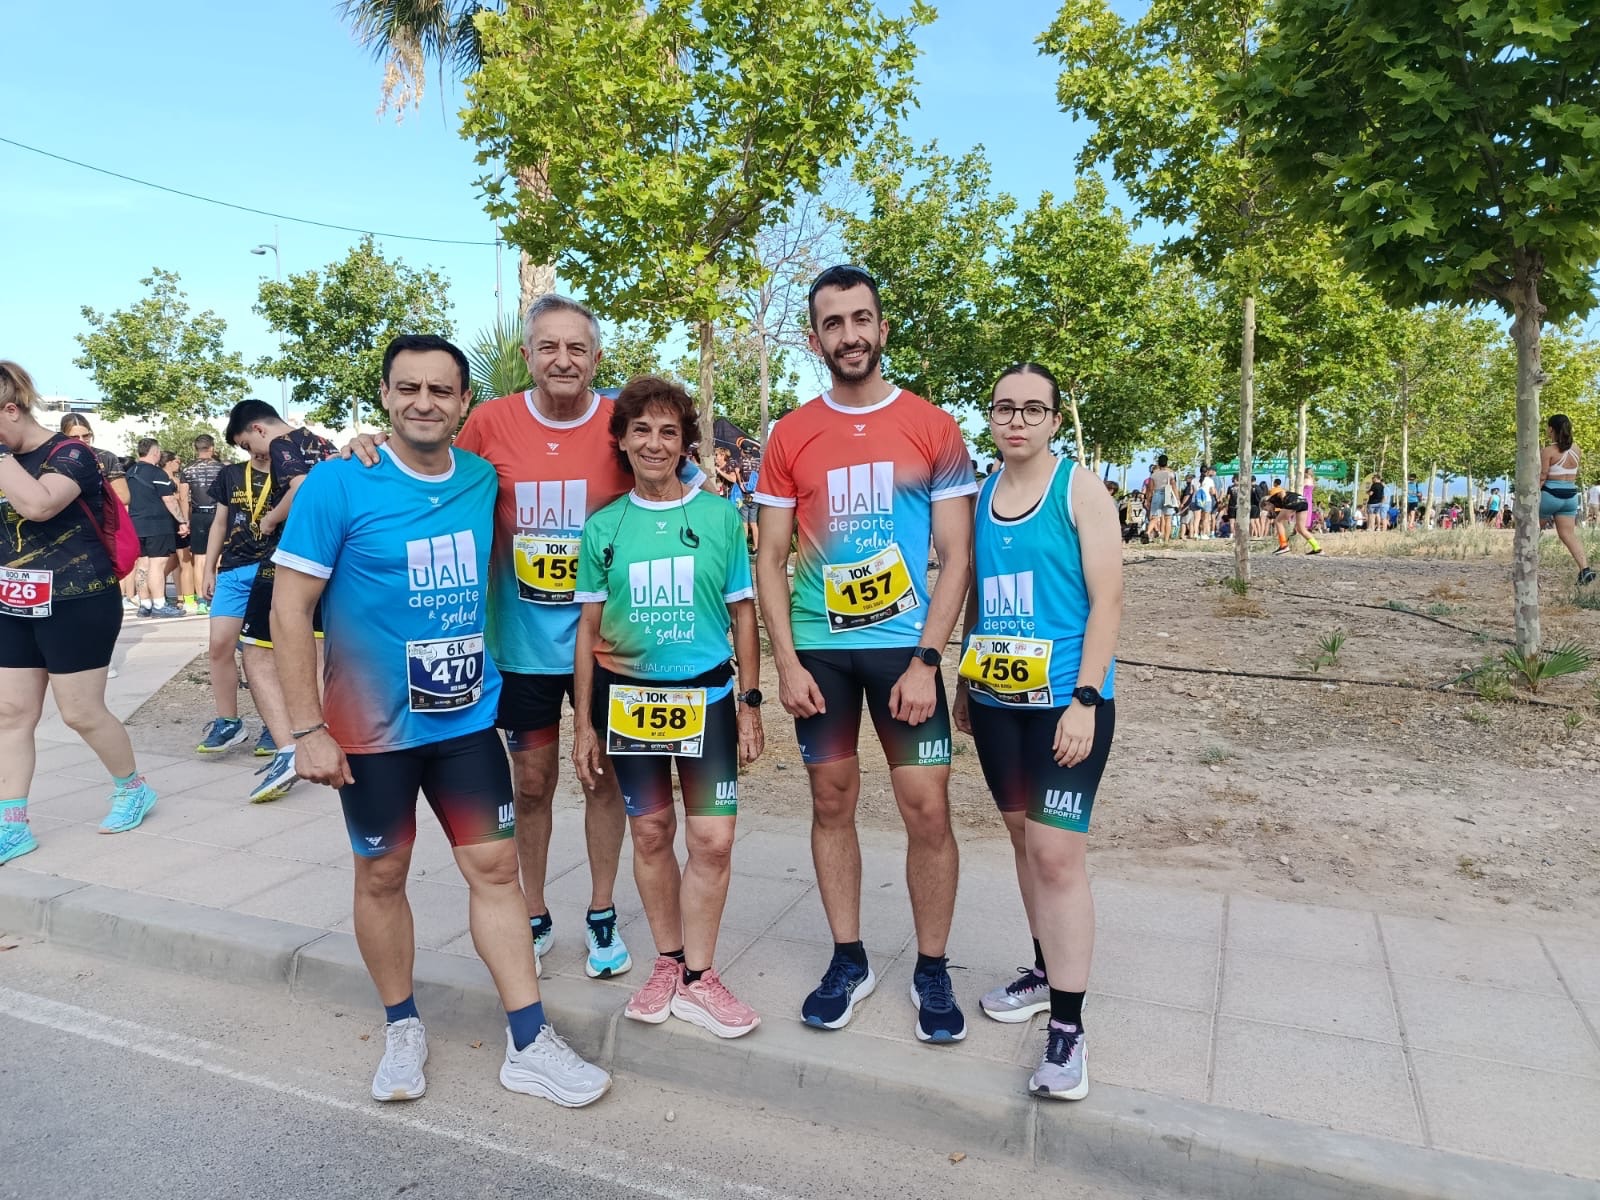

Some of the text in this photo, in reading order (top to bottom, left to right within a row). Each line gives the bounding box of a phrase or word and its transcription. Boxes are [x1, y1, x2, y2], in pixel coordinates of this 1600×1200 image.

[828, 517, 895, 534] deporte
[546, 544, 567, 555] 10K
[856, 531, 894, 554] salud
[533, 558, 579, 580] 159
[849, 564, 873, 580] 10K
[0, 581, 37, 600] 726
[842, 571, 893, 606] 157
[408, 589, 479, 610] deporte
[441, 603, 479, 631] salud
[629, 609, 695, 626] deporte
[983, 618, 1035, 634] deporte
[655, 623, 695, 645] salud
[446, 642, 465, 656] 6K
[992, 641, 1010, 654] 10K
[431, 656, 476, 684] 470
[633, 663, 695, 673] #UALrunning
[980, 656, 1029, 683] 156
[645, 692, 668, 703] 10K
[631, 706, 687, 730] 158
[918, 738, 950, 759] UAL
[716, 781, 738, 799] UA
[1045, 789, 1082, 814] UAL
[498, 802, 515, 823] UA
[1043, 807, 1081, 820] DEPORTES
